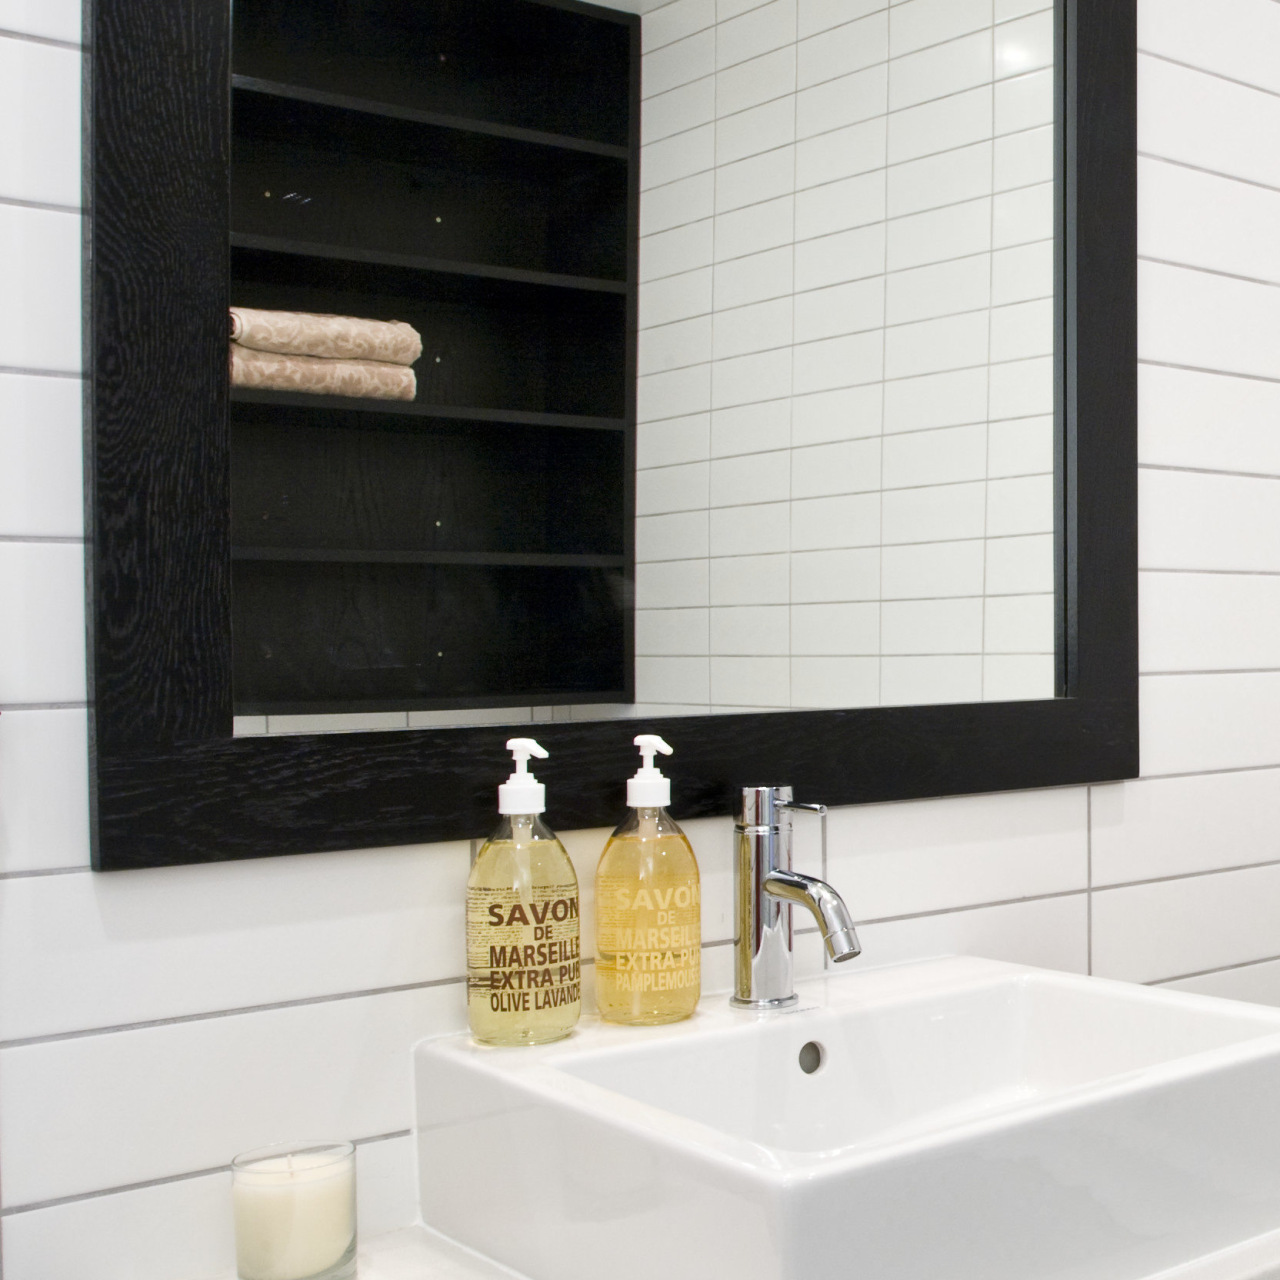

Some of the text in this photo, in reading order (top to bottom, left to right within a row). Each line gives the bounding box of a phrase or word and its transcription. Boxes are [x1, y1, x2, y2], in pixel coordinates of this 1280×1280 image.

[616, 884, 700, 910] SAVON
[488, 896, 579, 926] SAVON
[657, 910, 676, 925] DE
[534, 924, 553, 941] DE
[616, 925, 699, 950] MARSEIL
[489, 936, 579, 968] MARSEILLE
[615, 950, 676, 971] EXTRA
[490, 967, 554, 990] EXTRA
[490, 991, 530, 1012] OLIVE
